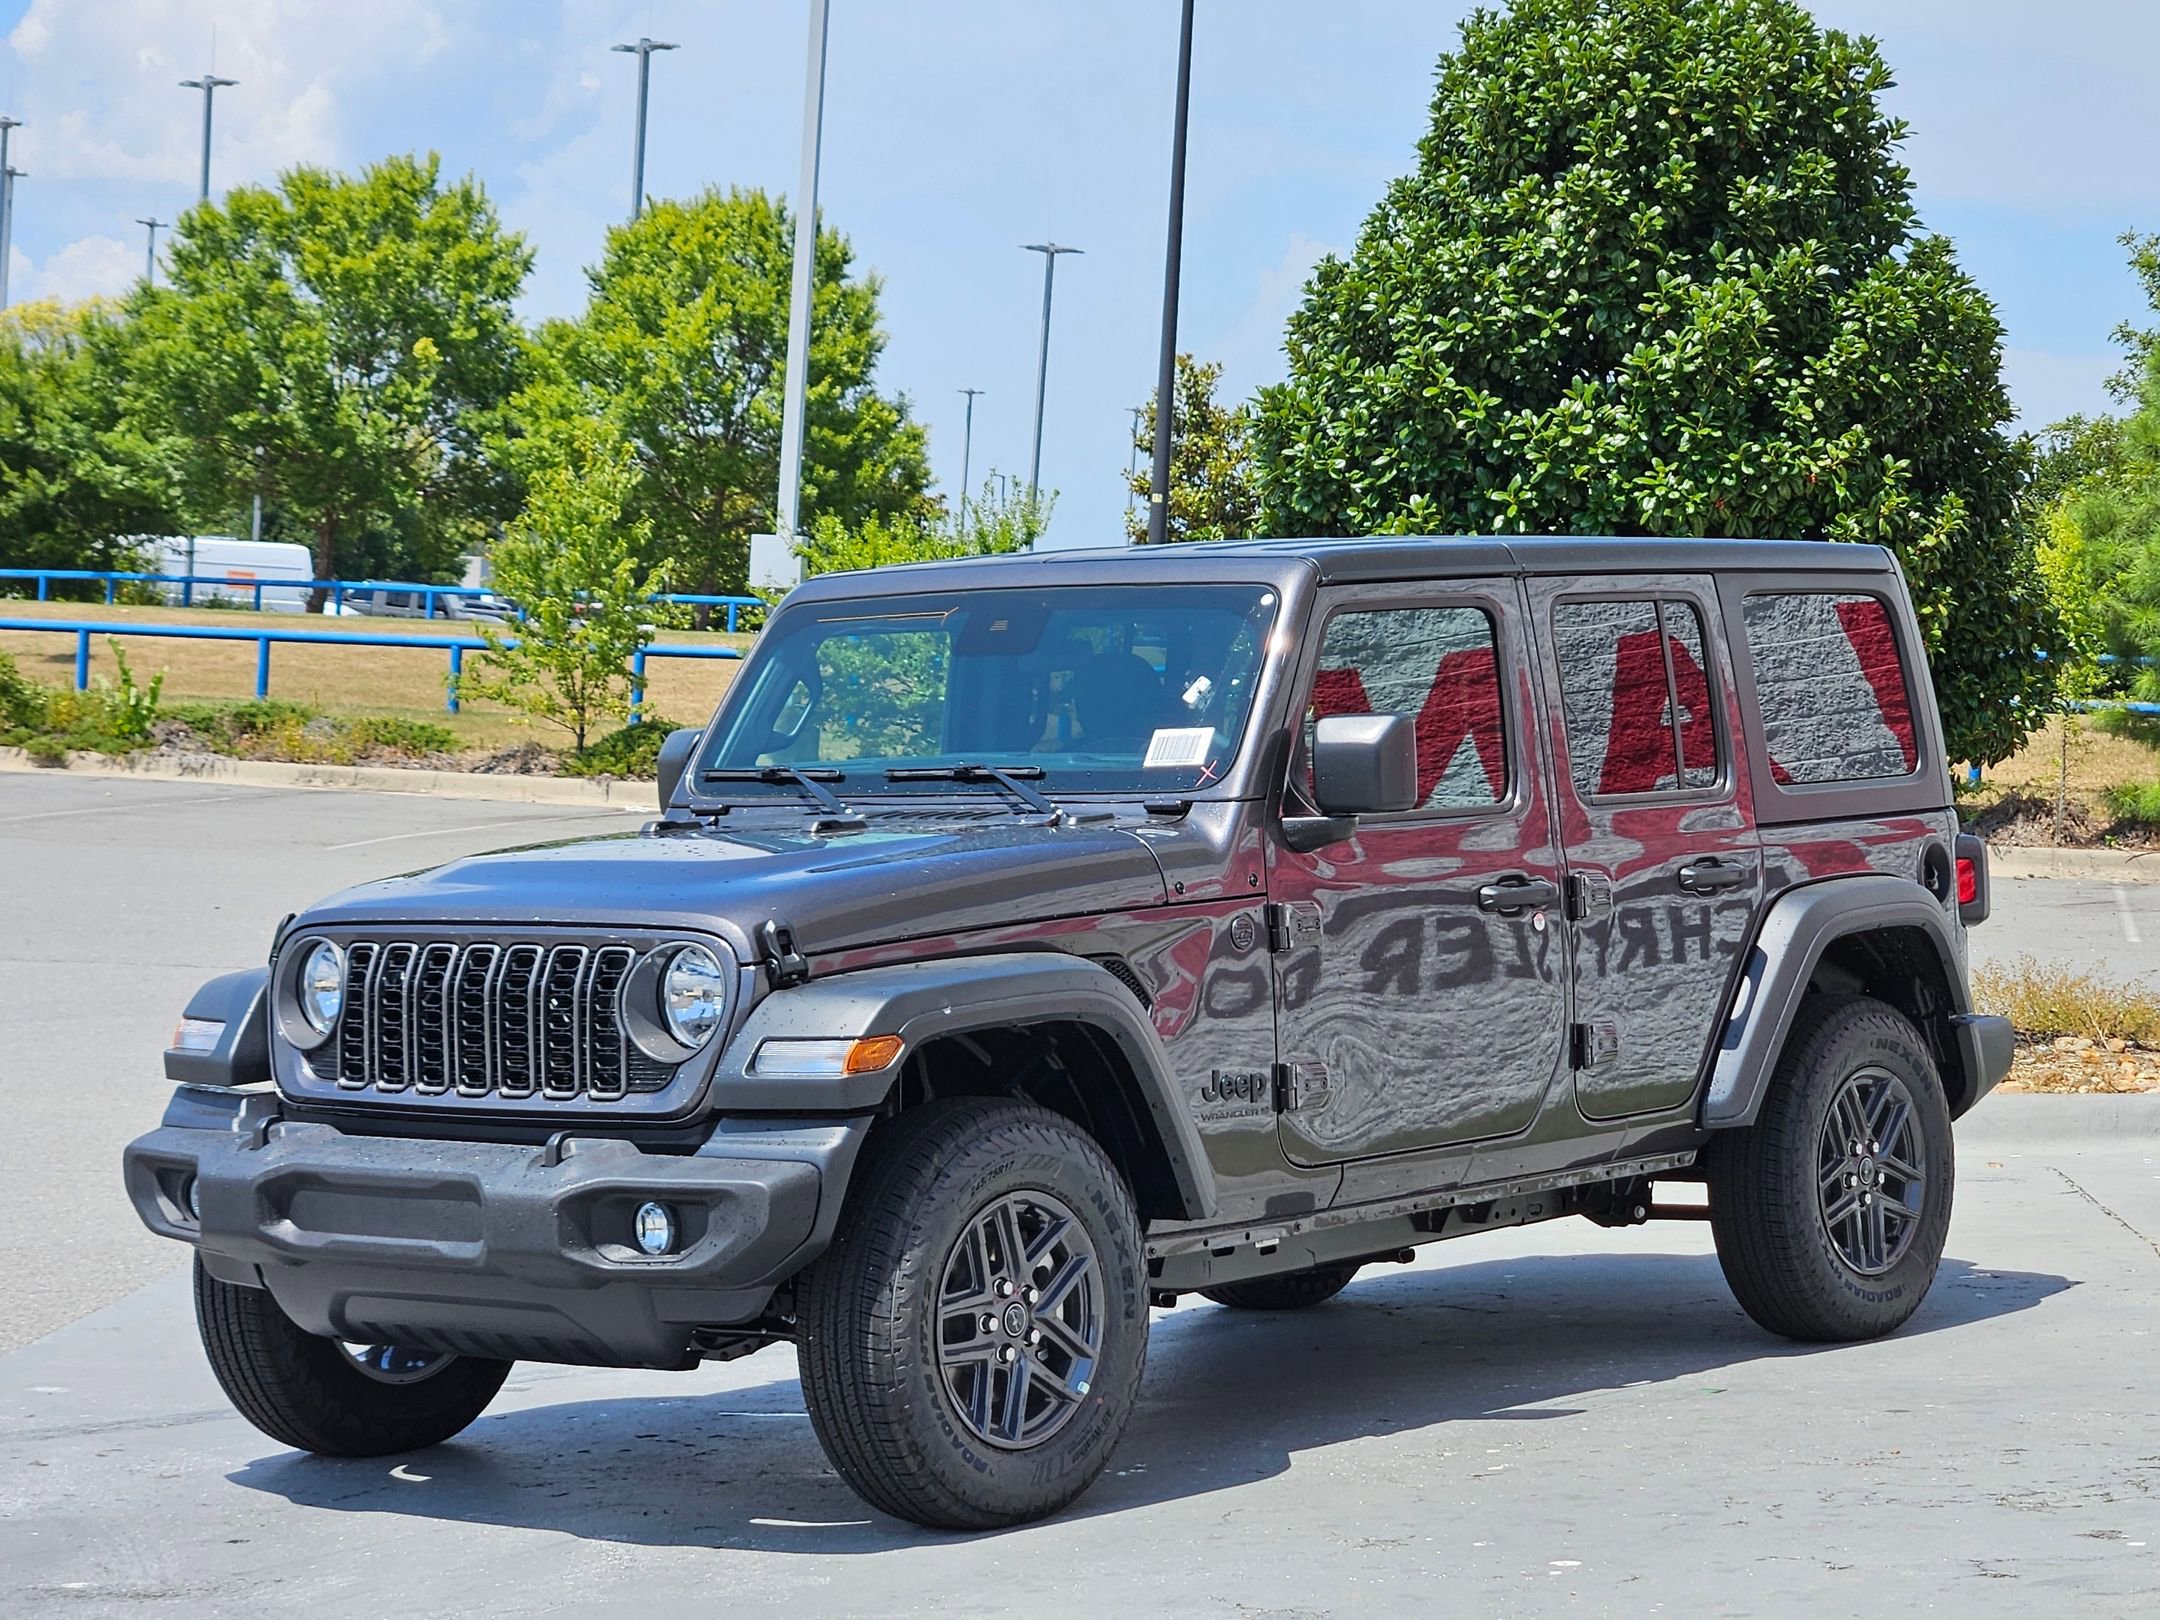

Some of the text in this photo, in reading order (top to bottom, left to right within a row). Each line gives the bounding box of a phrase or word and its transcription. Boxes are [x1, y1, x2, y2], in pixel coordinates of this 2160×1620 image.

[1201, 1070, 1267, 1103] Jeep
[1876, 1038, 1932, 1092] NEXEN
[1201, 1108, 1259, 1121] WRANGLER
[1090, 1189, 1135, 1320] NEXEN
[1844, 1279, 1902, 1302] ROADIAN
[925, 1374, 988, 1474] ROADIAN
